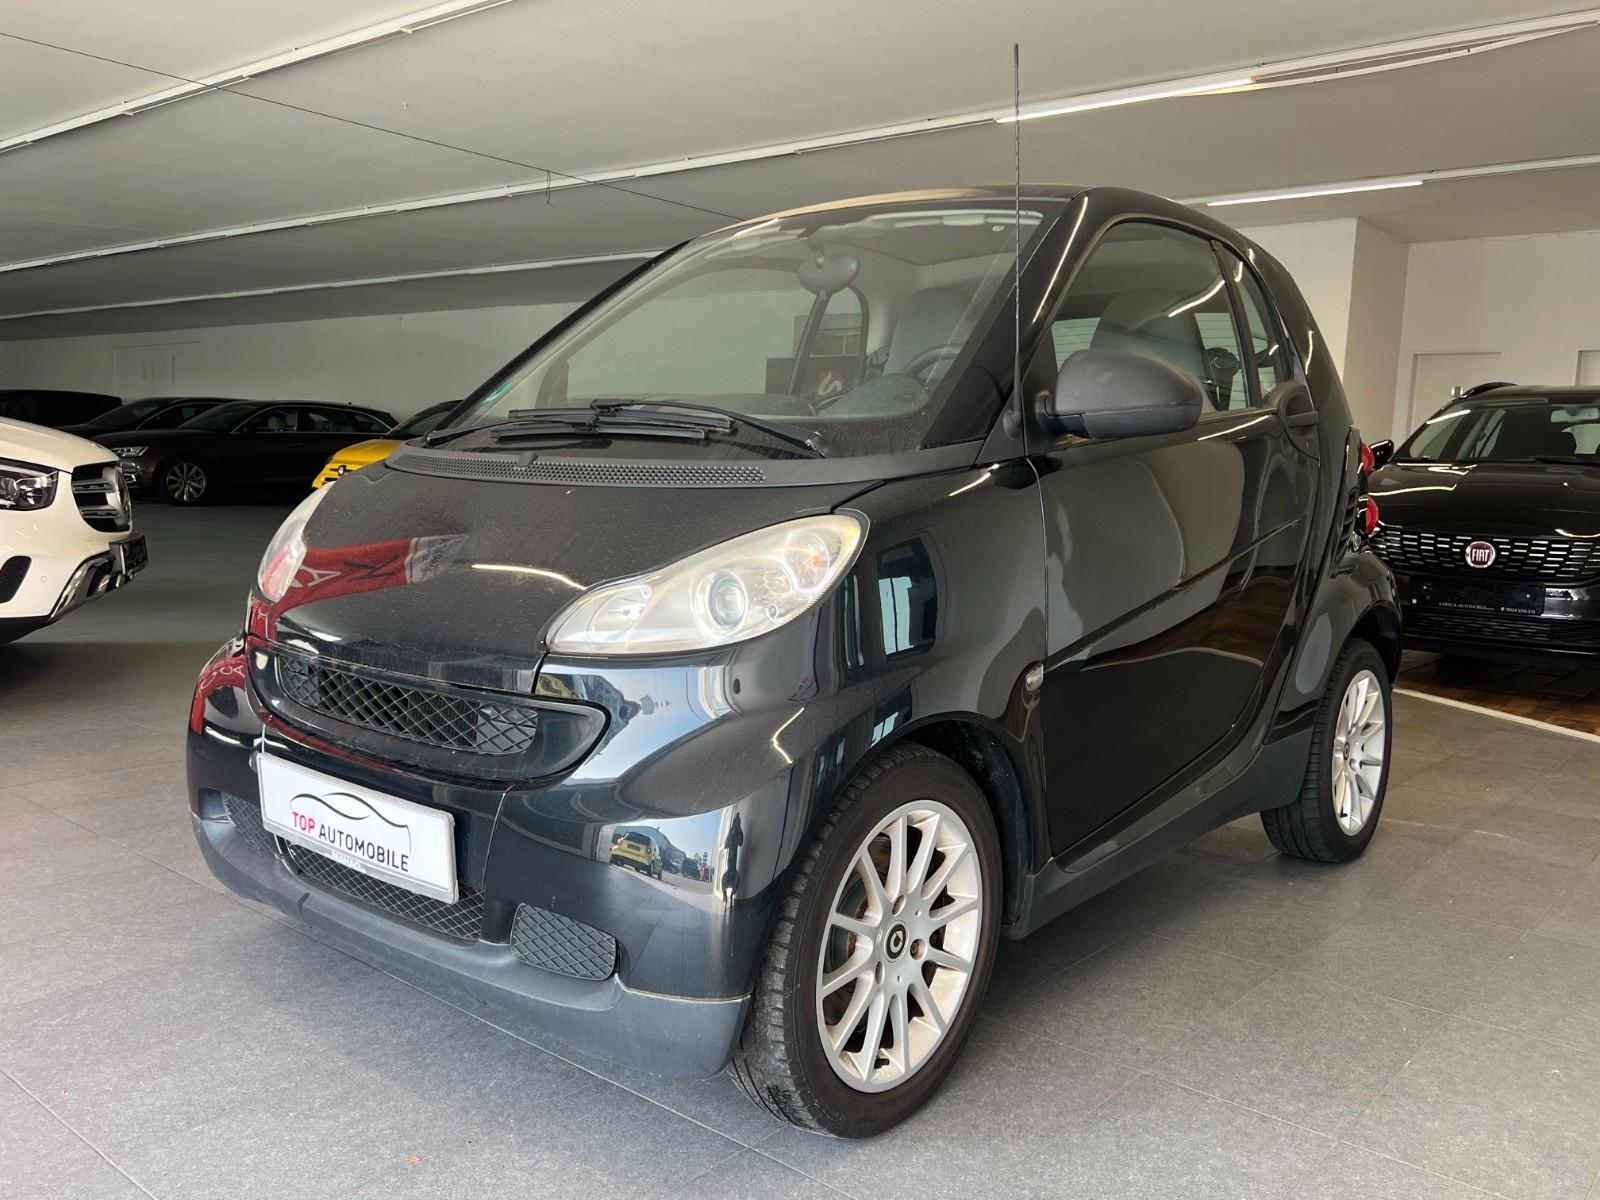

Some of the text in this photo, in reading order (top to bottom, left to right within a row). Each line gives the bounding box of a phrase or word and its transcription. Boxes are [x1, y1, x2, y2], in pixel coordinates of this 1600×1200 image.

[1472, 549, 1490, 562] FIAT
[292, 811, 315, 833] TOP
[318, 823, 409, 872] AUTOMOBILE
